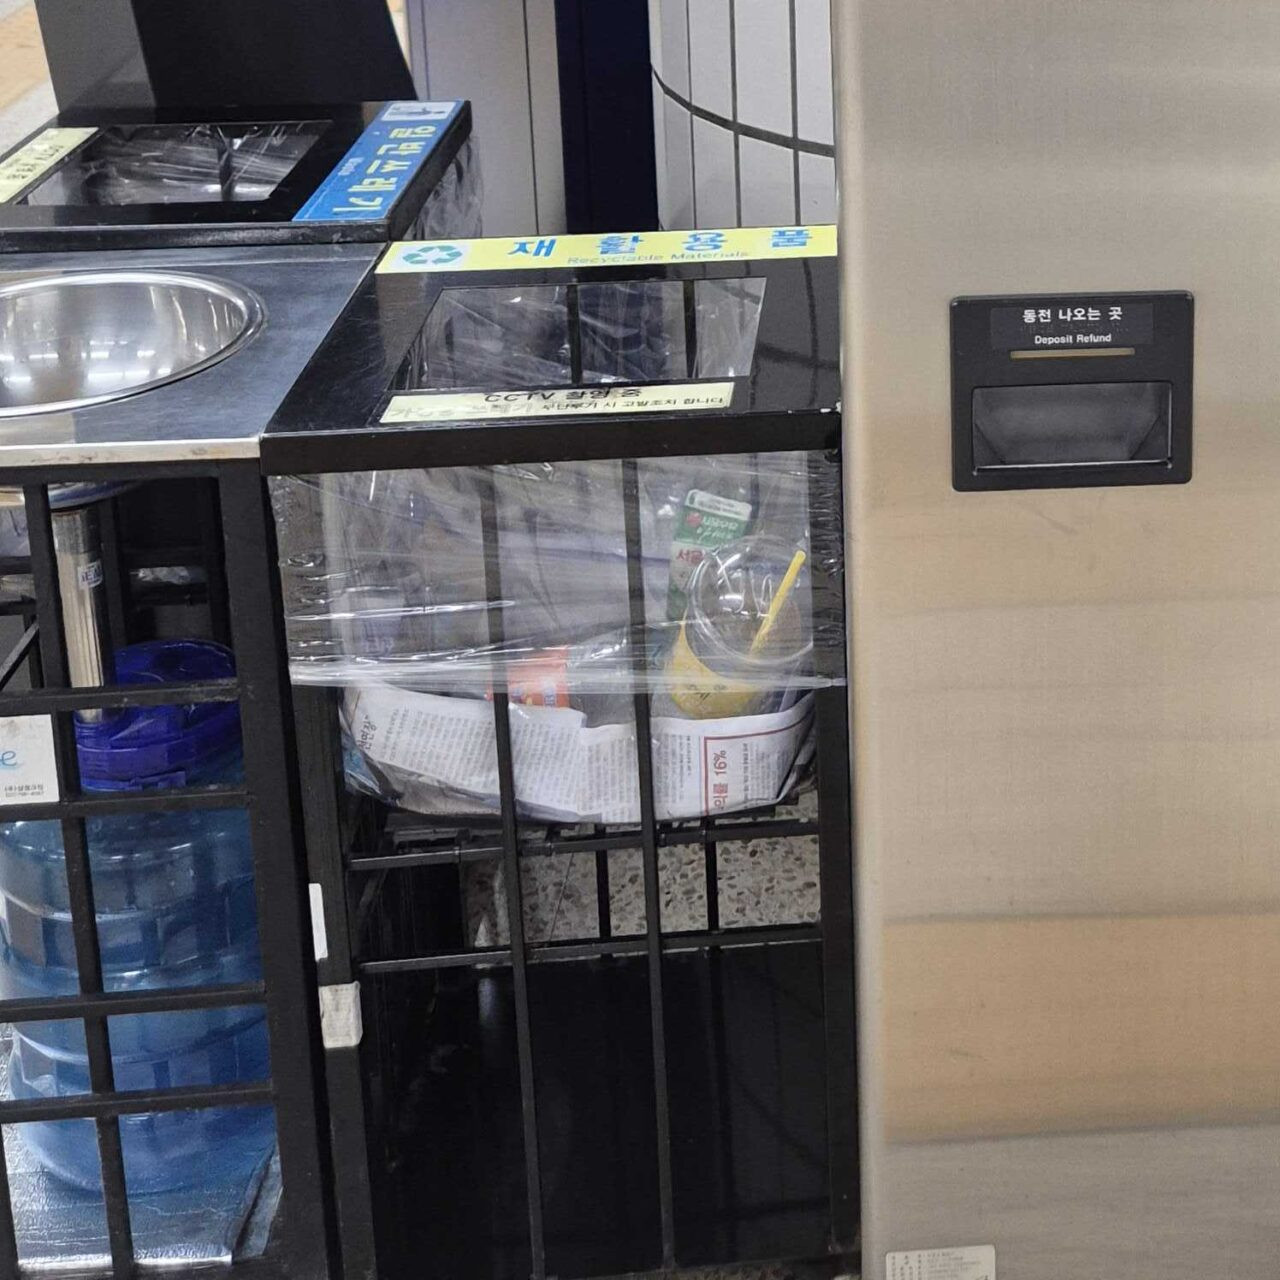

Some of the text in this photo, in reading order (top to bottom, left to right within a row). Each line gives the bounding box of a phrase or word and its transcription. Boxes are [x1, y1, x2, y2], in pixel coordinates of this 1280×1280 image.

[332, 125, 437, 212] 일반쓰레기
[1022, 306, 1123, 324] 동전 나오는 곳
[1034, 332, 1112, 346] Deposit Refund
[484, 392, 555, 403] CCTV
